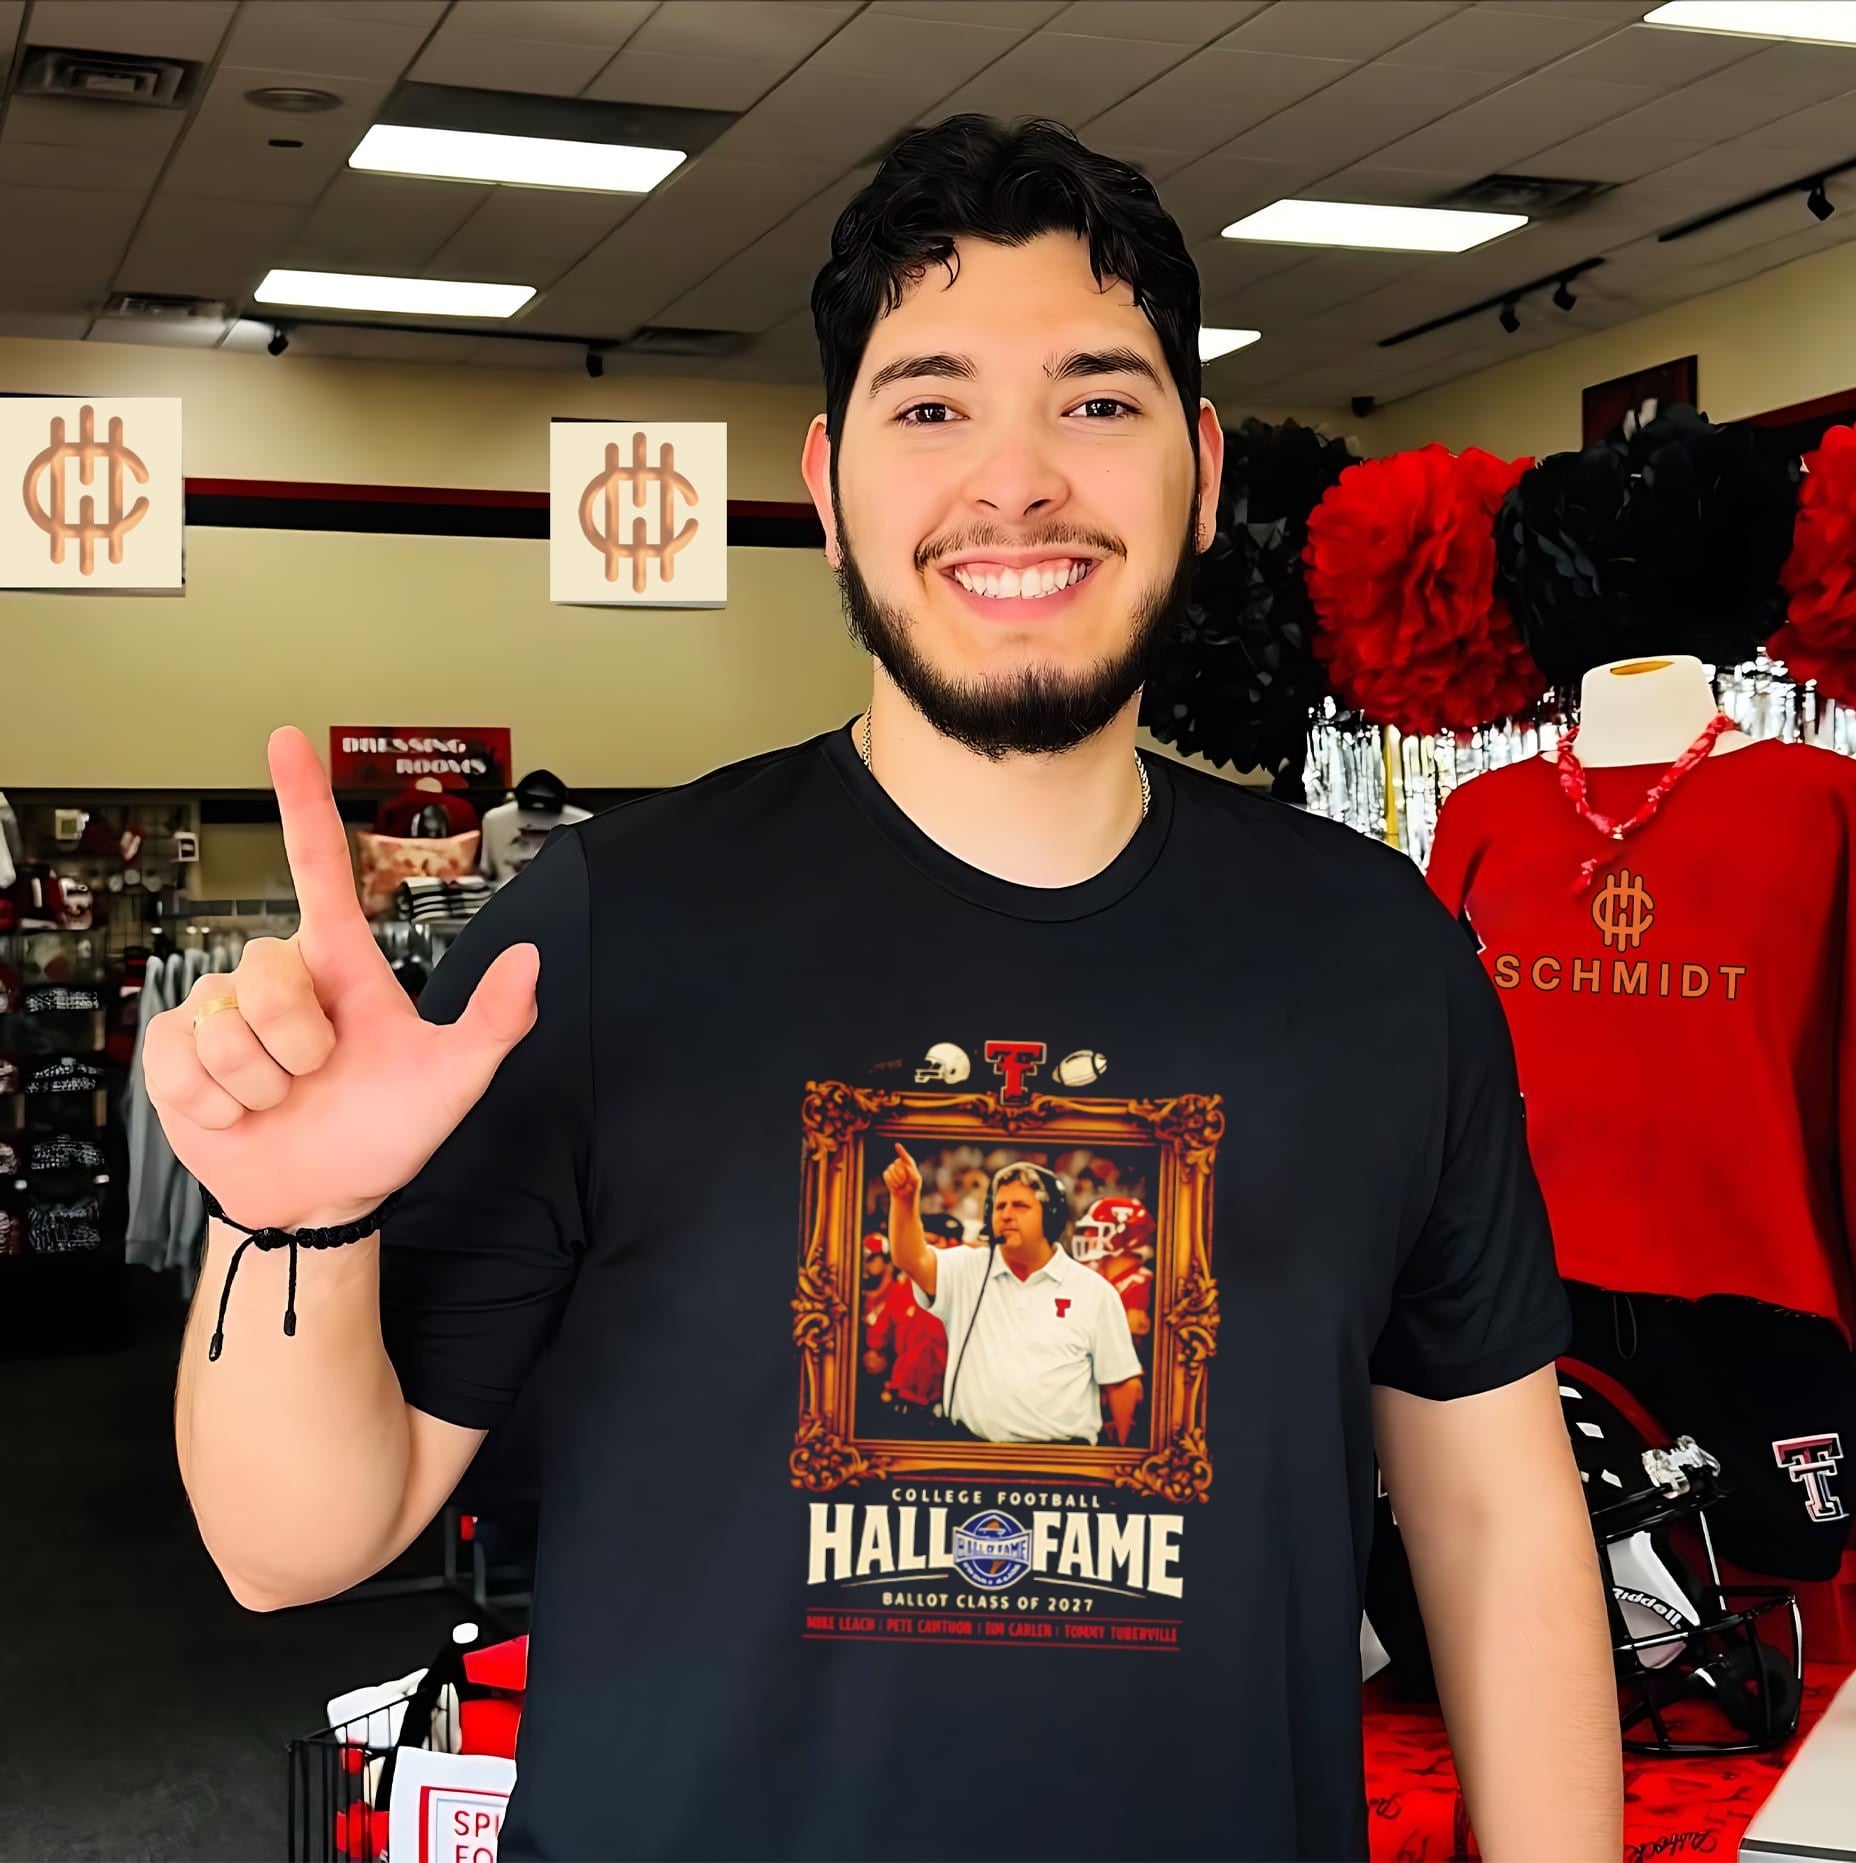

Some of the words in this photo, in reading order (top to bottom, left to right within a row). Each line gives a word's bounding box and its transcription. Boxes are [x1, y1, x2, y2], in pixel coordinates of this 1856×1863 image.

[342, 737, 467, 754] DRESSING
[396, 758, 487, 775] ROOMS
[1494, 954, 1746, 1000] SCHMIDT
[891, 1488, 983, 1504] COLLEGE
[998, 1491, 1100, 1508] FOOTBALL
[806, 1502, 953, 1585] HALL
[1032, 1510, 1184, 1598] FAME
[882, 1592, 949, 1607] BALLOT
[956, 1594, 1010, 1610] CLASS
[1017, 1596, 1040, 1611] OF
[1048, 1598, 1093, 1613] 2027
[806, 1616, 835, 1631] MIKE
[838, 1616, 875, 1632] LEACH
[1064, 1624, 1105, 1640] TOMMY
